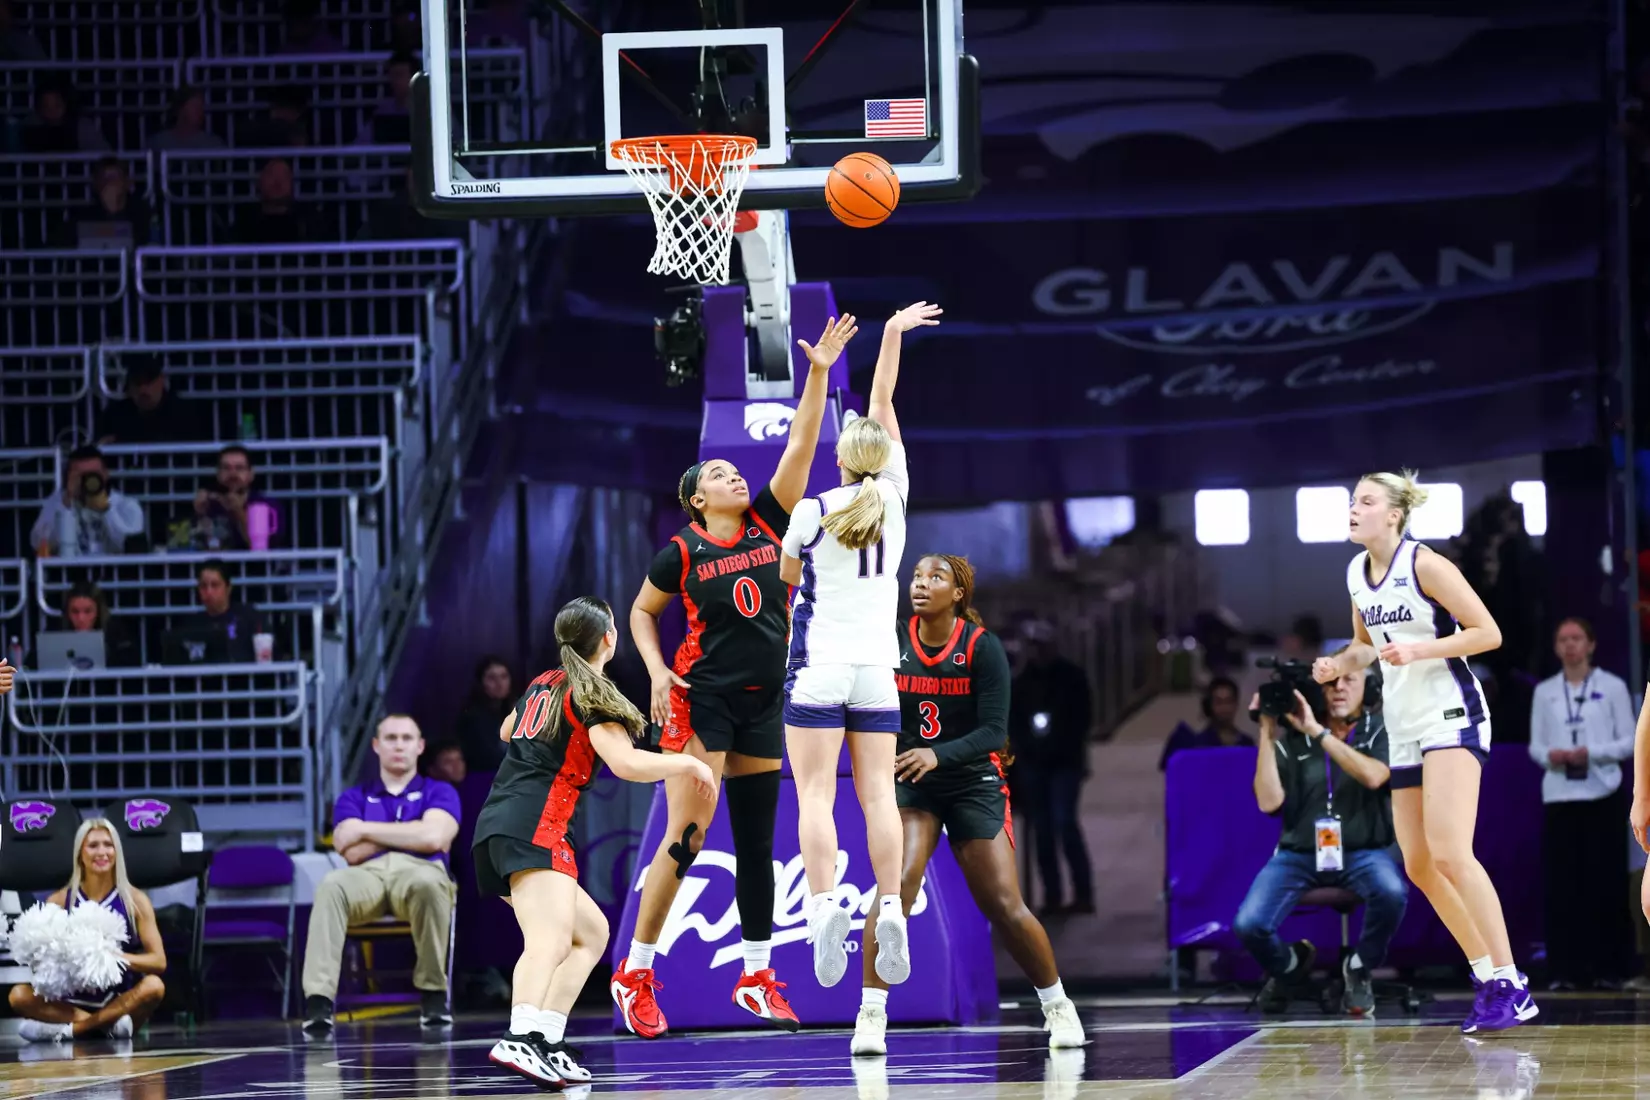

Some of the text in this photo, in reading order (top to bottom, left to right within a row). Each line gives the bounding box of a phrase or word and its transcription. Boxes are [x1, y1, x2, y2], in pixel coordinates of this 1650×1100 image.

[451, 182, 501, 196] SPALDING
[1032, 243, 1513, 314] GLAVAN
[696, 544, 778, 582] SAN DIEGO STATE
[733, 576, 762, 618] 0
[909, 676, 940, 695] DIEGO
[940, 676, 971, 695] STATE
[511, 690, 551, 739] 10
[918, 700, 942, 739] 3
